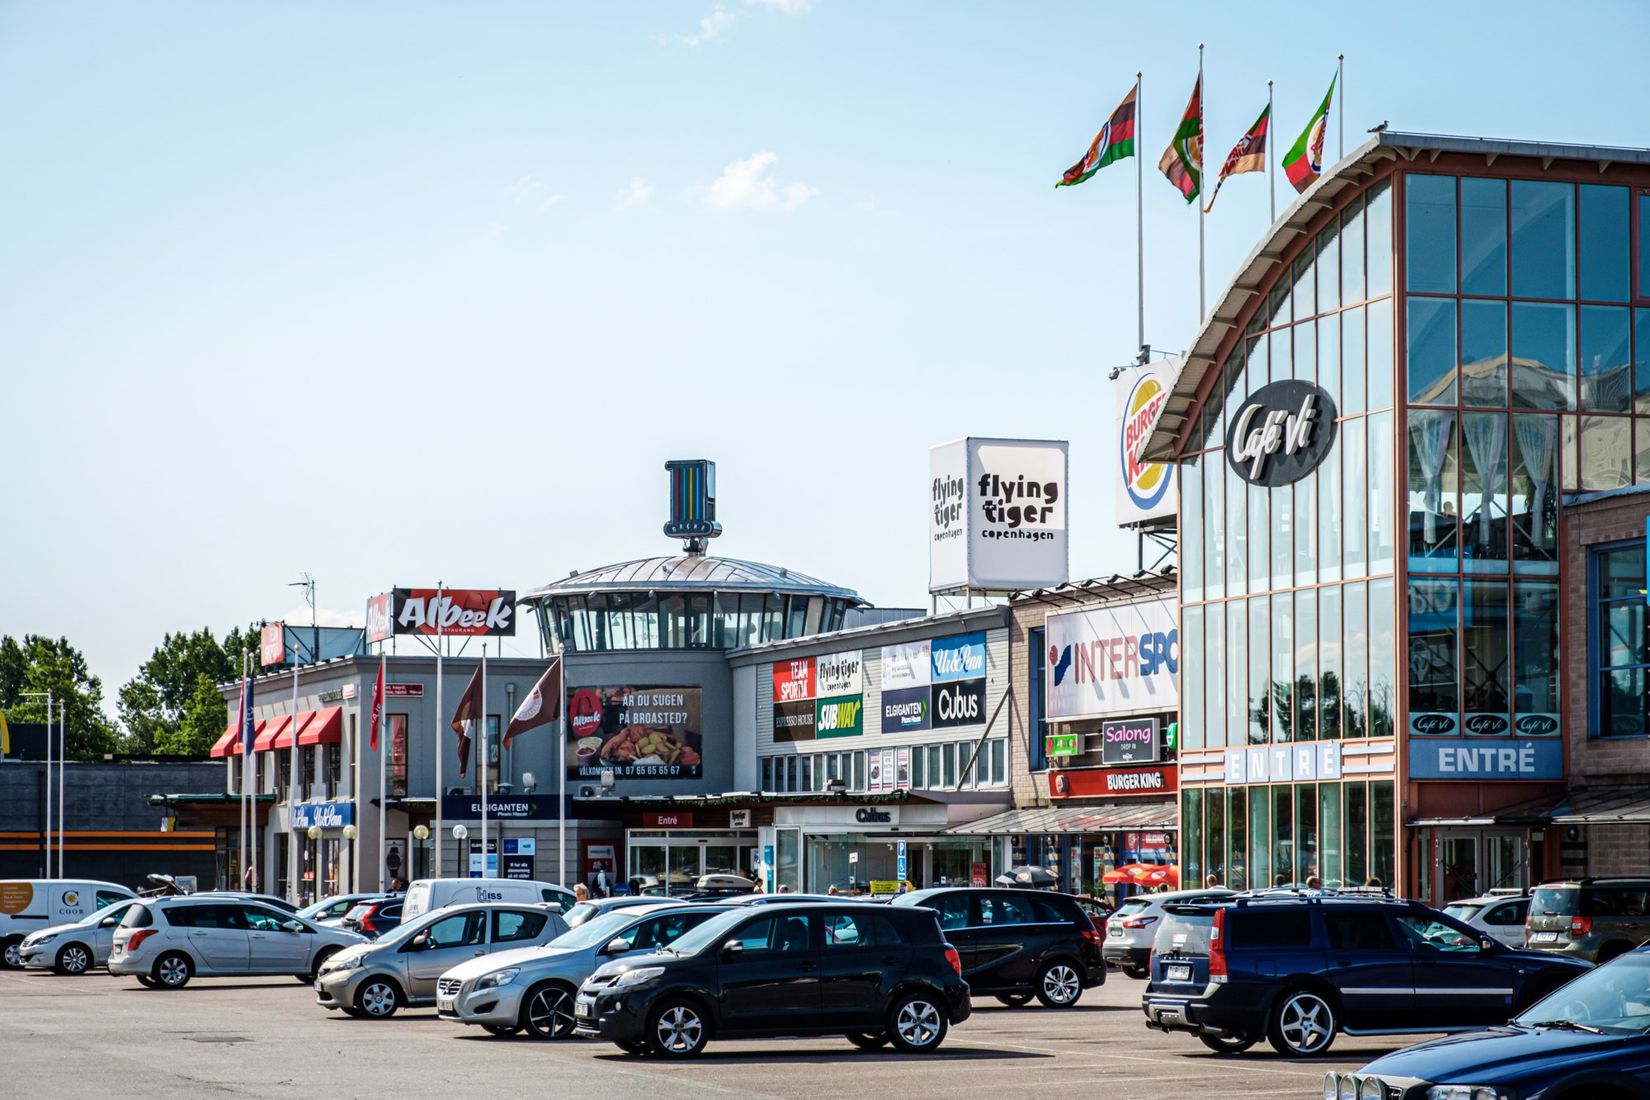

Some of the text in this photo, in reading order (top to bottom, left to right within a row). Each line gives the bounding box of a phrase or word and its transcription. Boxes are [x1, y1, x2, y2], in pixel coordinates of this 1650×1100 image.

[1126, 391, 1167, 451] BURGE
[1232, 403, 1288, 480] Café
[1285, 394, 1316, 456] Vi
[932, 474, 964, 505] flying
[978, 473, 1058, 504] flying
[934, 502, 962, 529] tiger
[982, 498, 1053, 529] tiger
[934, 528, 962, 541] copenhagen
[982, 529, 1054, 541] copenhagen
[790, 660, 808, 680] TEAM
[819, 659, 859, 682] flying tiger
[637, 695, 650, 706] DU
[652, 694, 684, 706] SUGEN
[781, 680, 808, 700] SPORTIA
[885, 702, 921, 717] ELGIGANTEN
[938, 685, 977, 720] Cubus
[633, 712, 688, 724] BROASTED?
[798, 713, 813, 725] HOUSE
[818, 702, 857, 731] SUBWAY
[1106, 725, 1151, 744] Salong
[1231, 739, 1336, 779] ENTRÉ
[1438, 742, 1535, 772] ENTRÉ
[625, 766, 634, 775] 07
[1106, 771, 1162, 790] BURGER KING
[657, 815, 678, 825] Entré
